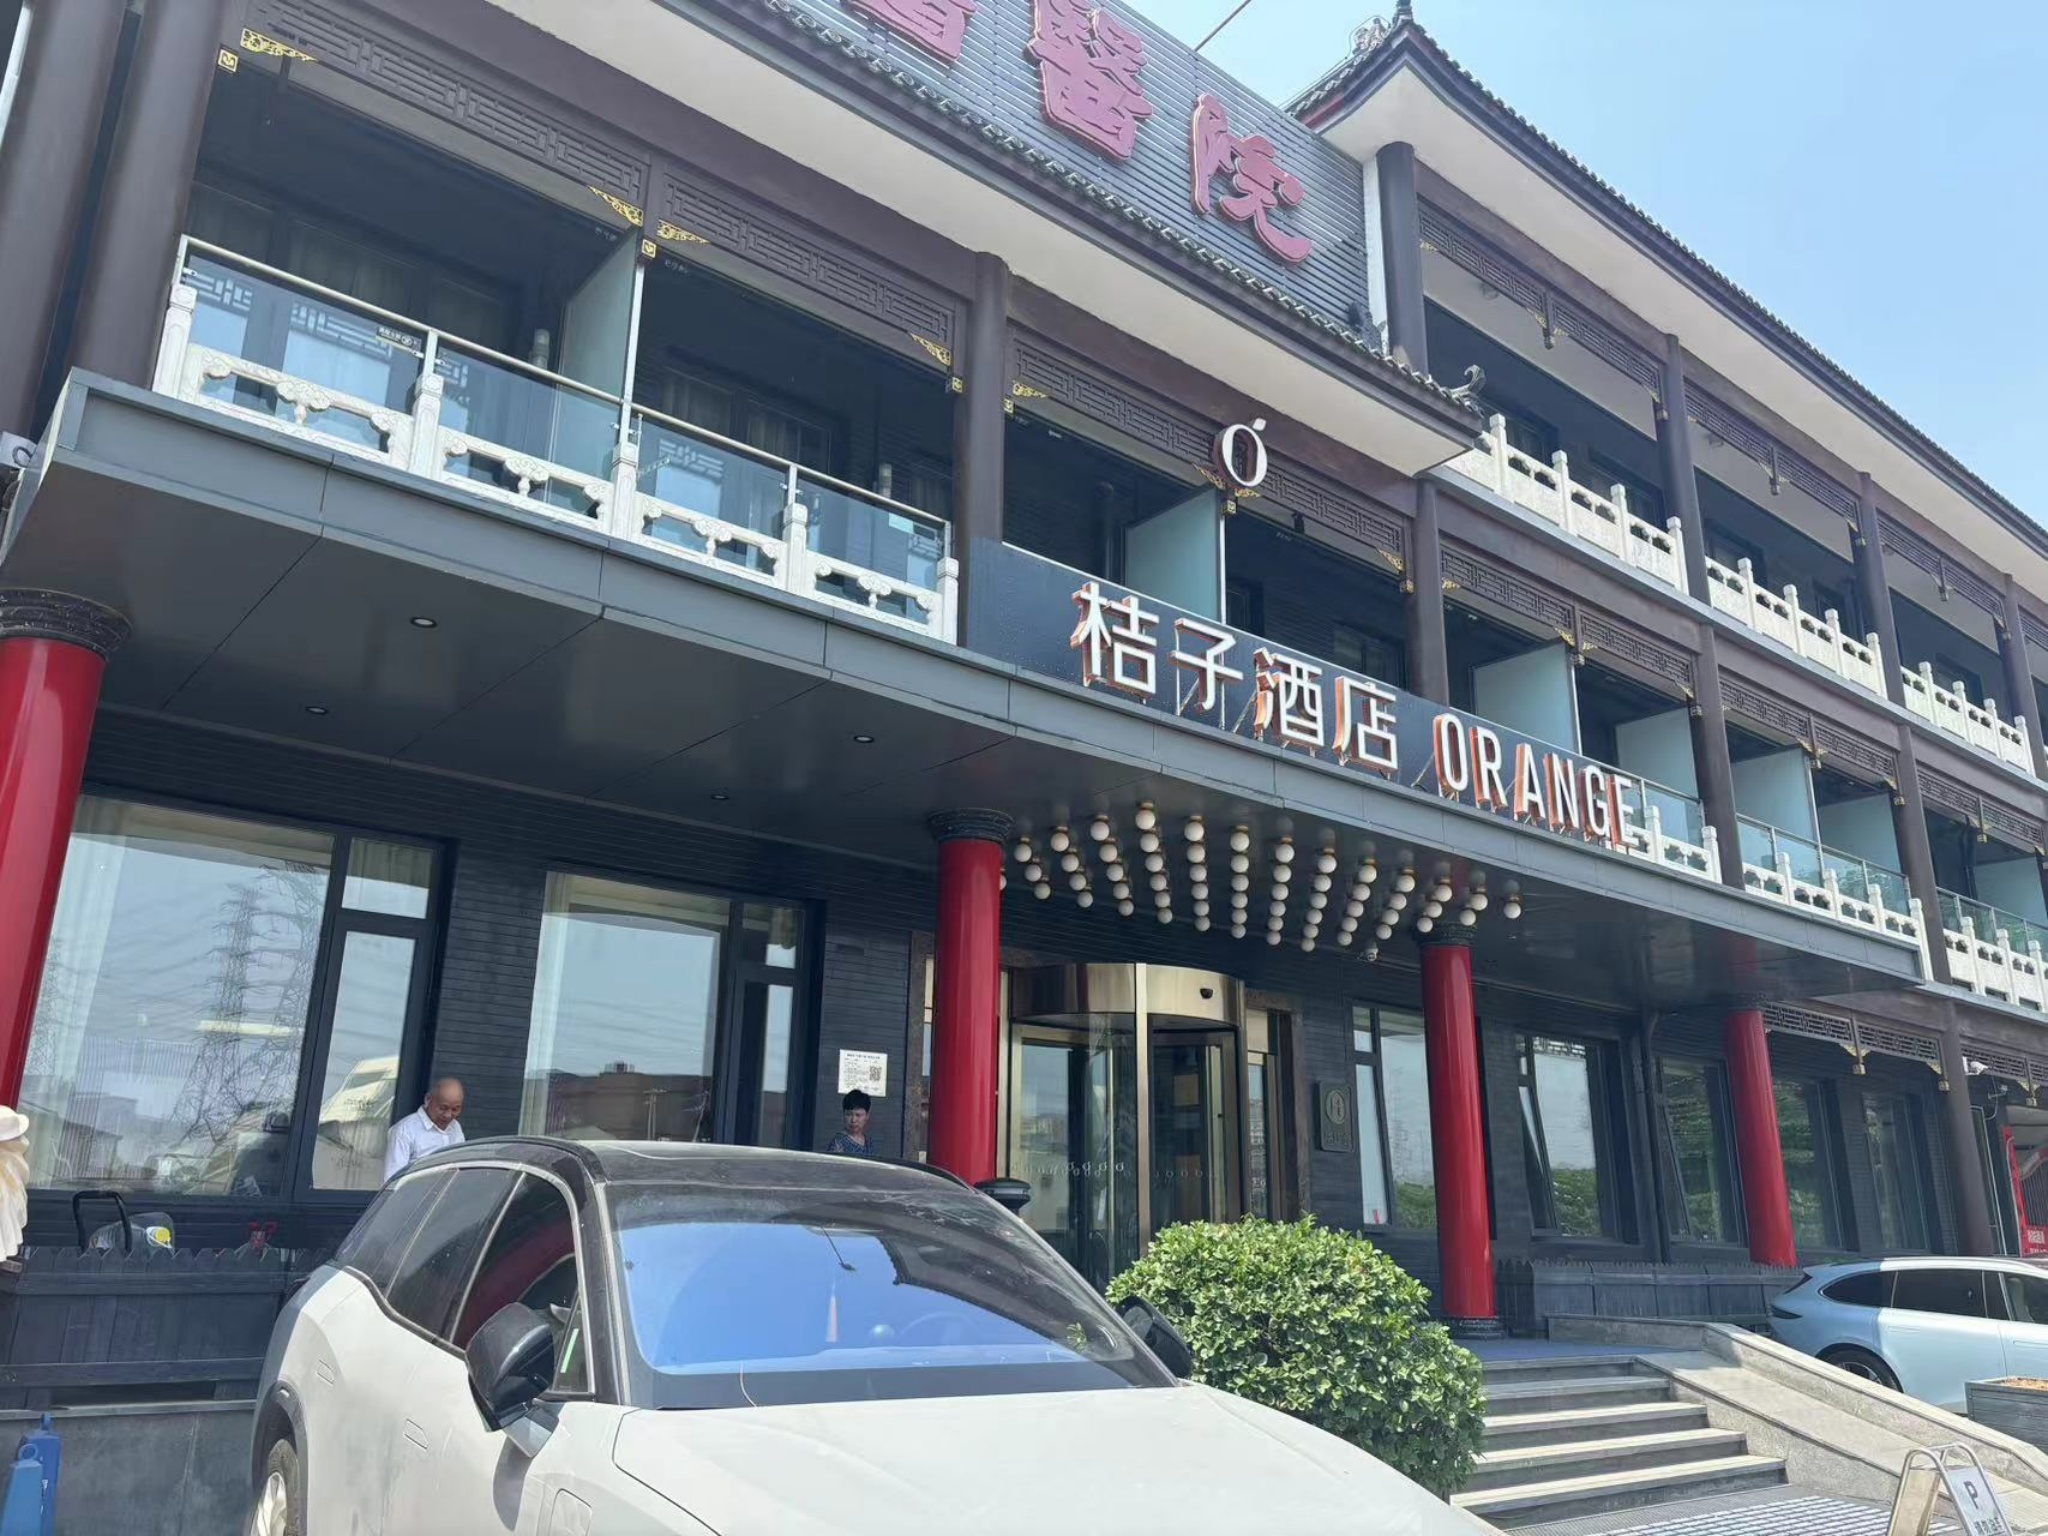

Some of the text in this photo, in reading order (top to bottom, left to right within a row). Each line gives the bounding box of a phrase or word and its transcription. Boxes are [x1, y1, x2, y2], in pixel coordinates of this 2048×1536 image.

[1070, 581, 1640, 847] 桔子酒店 ORANGE
[1963, 1481, 1979, 1510] P
